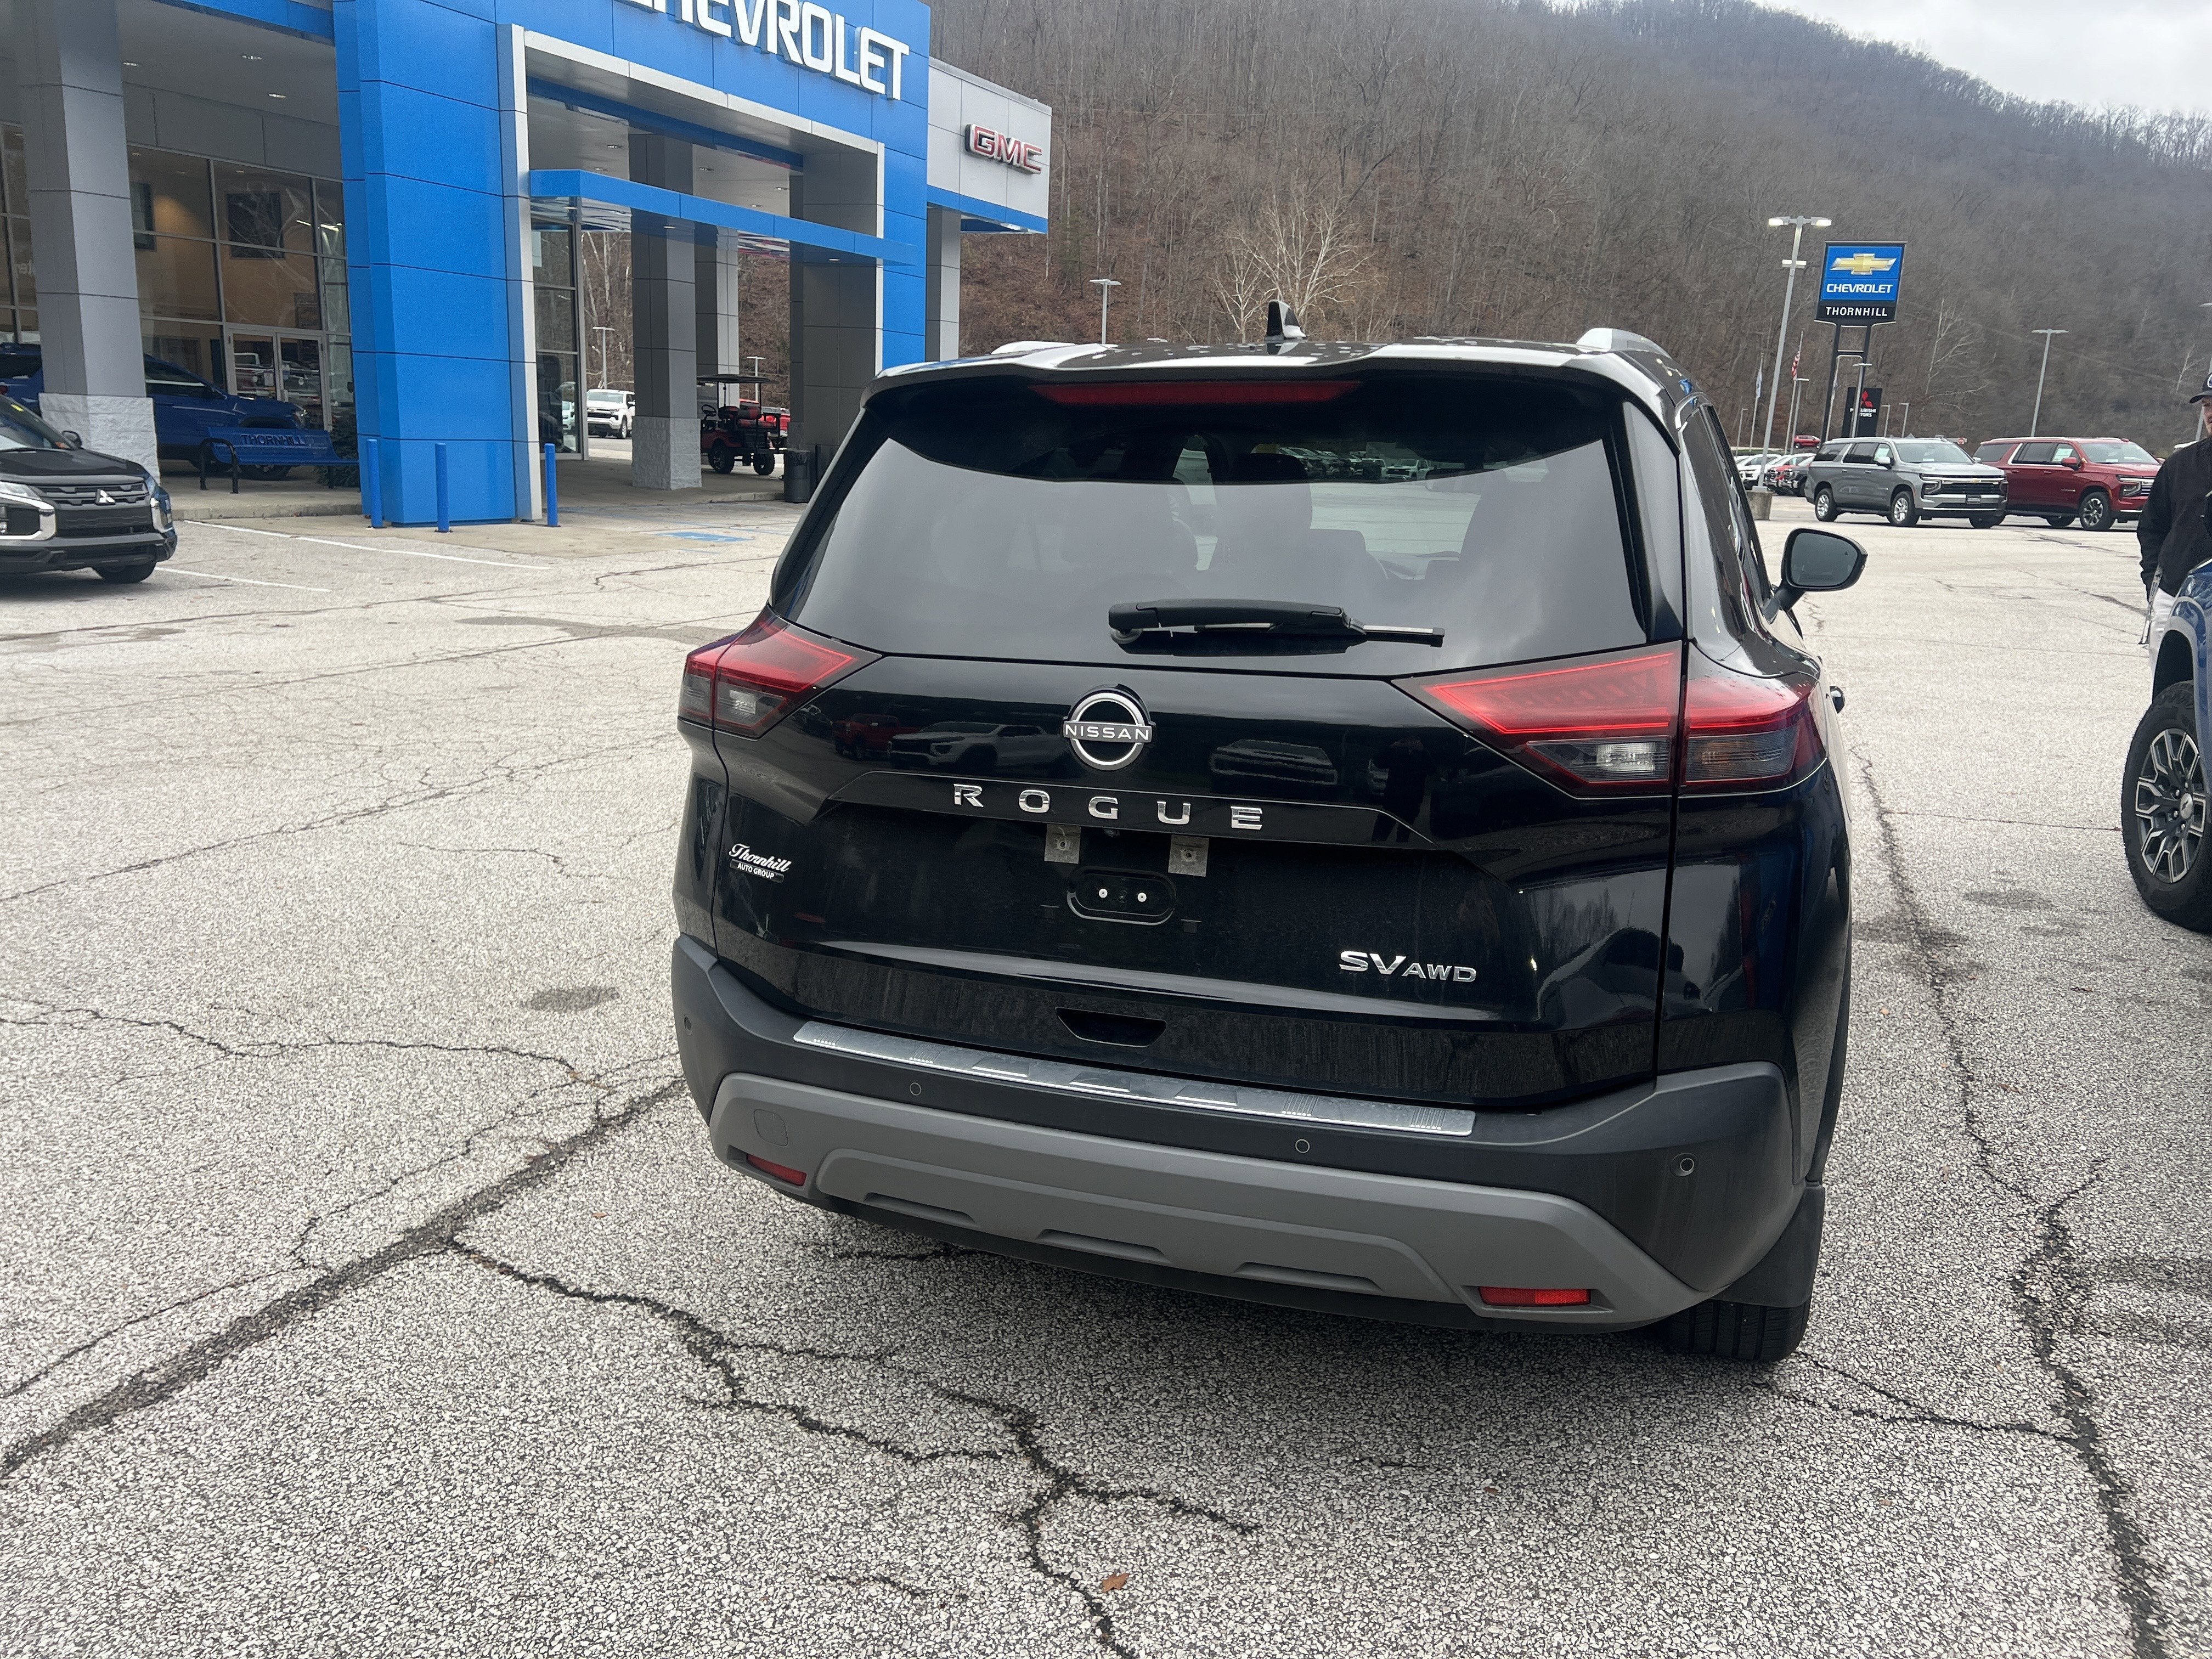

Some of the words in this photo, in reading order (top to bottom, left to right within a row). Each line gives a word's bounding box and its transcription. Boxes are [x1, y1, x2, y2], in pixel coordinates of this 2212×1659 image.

[614, 0, 910, 100] VROLET
[969, 124, 1042, 174] GMC
[1826, 284, 1893, 294] CHEVROLET
[1826, 307, 1888, 317] THORNHILL
[240, 435, 306, 446] THORNHILL
[1065, 724, 1149, 740] NISSAN
[953, 783, 1262, 830] ROGUE
[729, 843, 792, 872] Thornhill
[737, 863, 753, 873] AUTO
[753, 868, 775, 879] GROUP
[1339, 951, 1407, 975] SV
[1401, 962, 1476, 982] AWD
